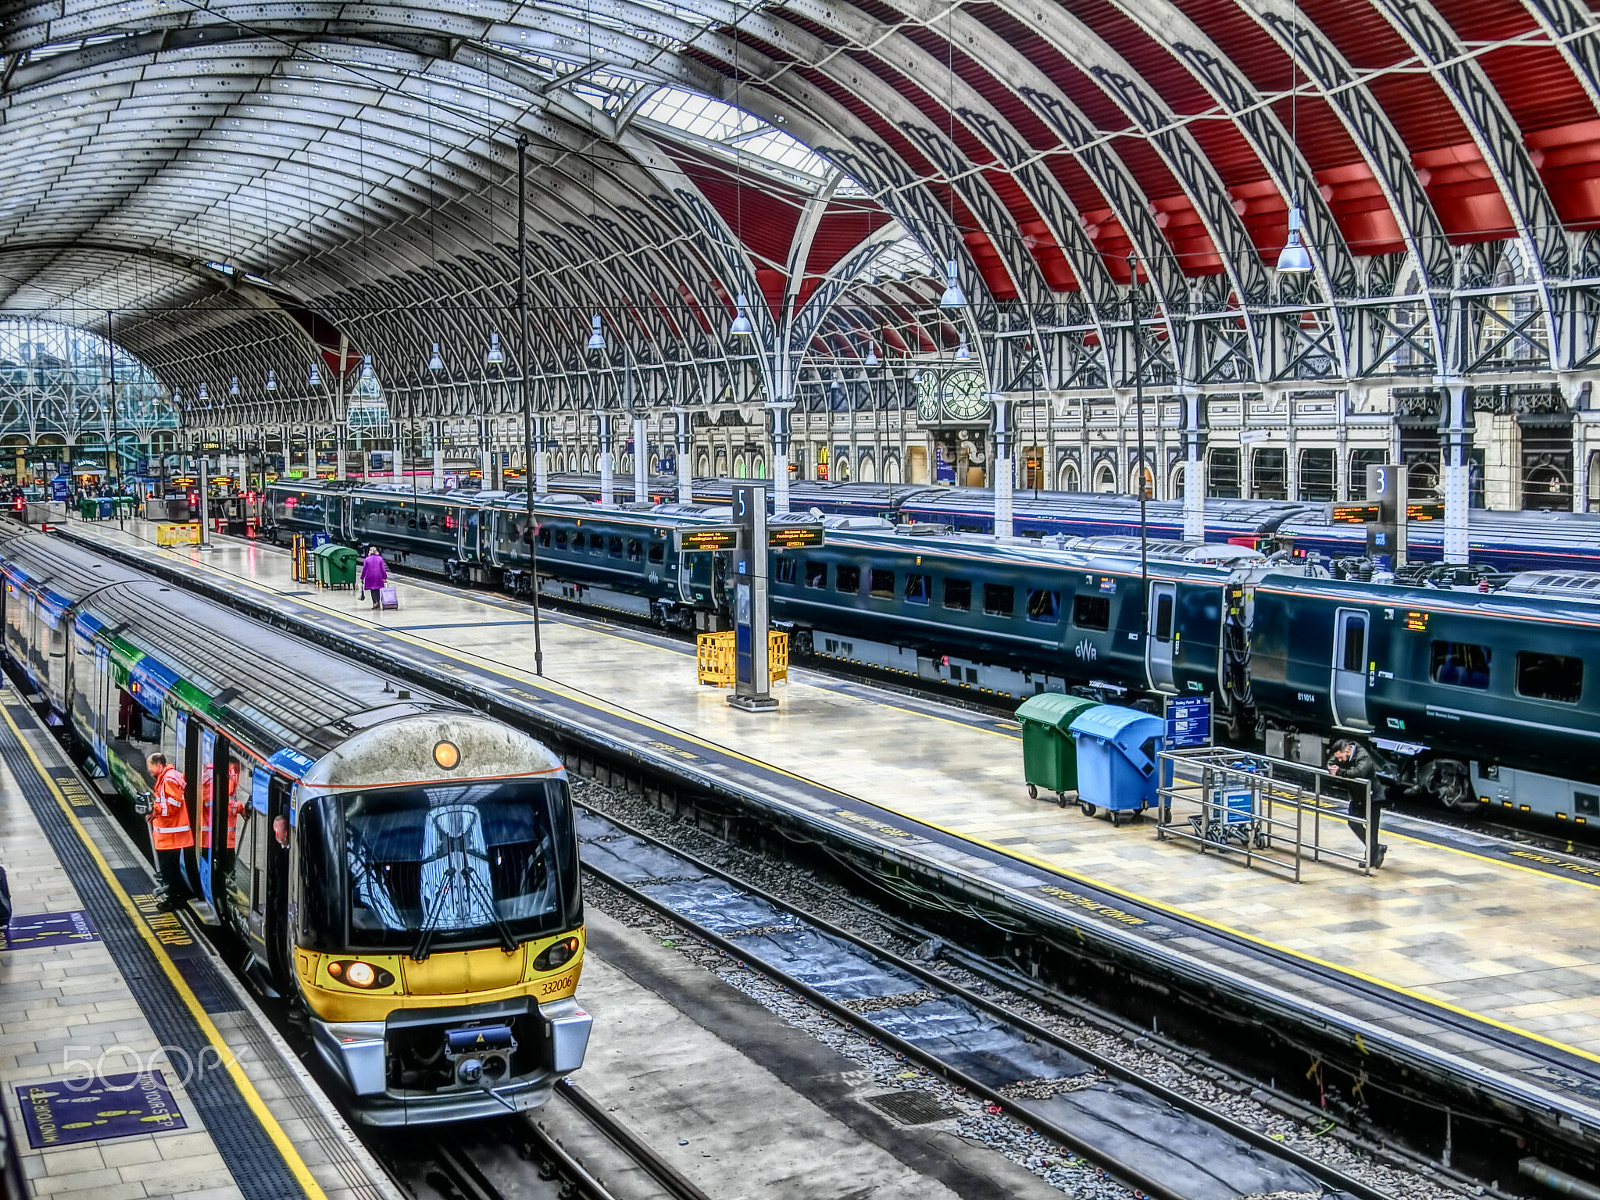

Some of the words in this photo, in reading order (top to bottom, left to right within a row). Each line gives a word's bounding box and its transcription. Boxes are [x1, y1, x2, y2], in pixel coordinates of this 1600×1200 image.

[1376, 468, 1386, 494] 3
[738, 489, 745, 516] 5
[1075, 638, 1097, 662] GWR
[156, 929, 193, 945] GAP
[541, 974, 573, 996] 332006
[140, 1072, 157, 1091] MIND
[29, 1087, 49, 1105] STEP
[144, 1089, 166, 1109] YOUR
[34, 1104, 54, 1124] YOUR
[152, 1107, 175, 1127] STEP
[39, 1122, 60, 1144] MIND
